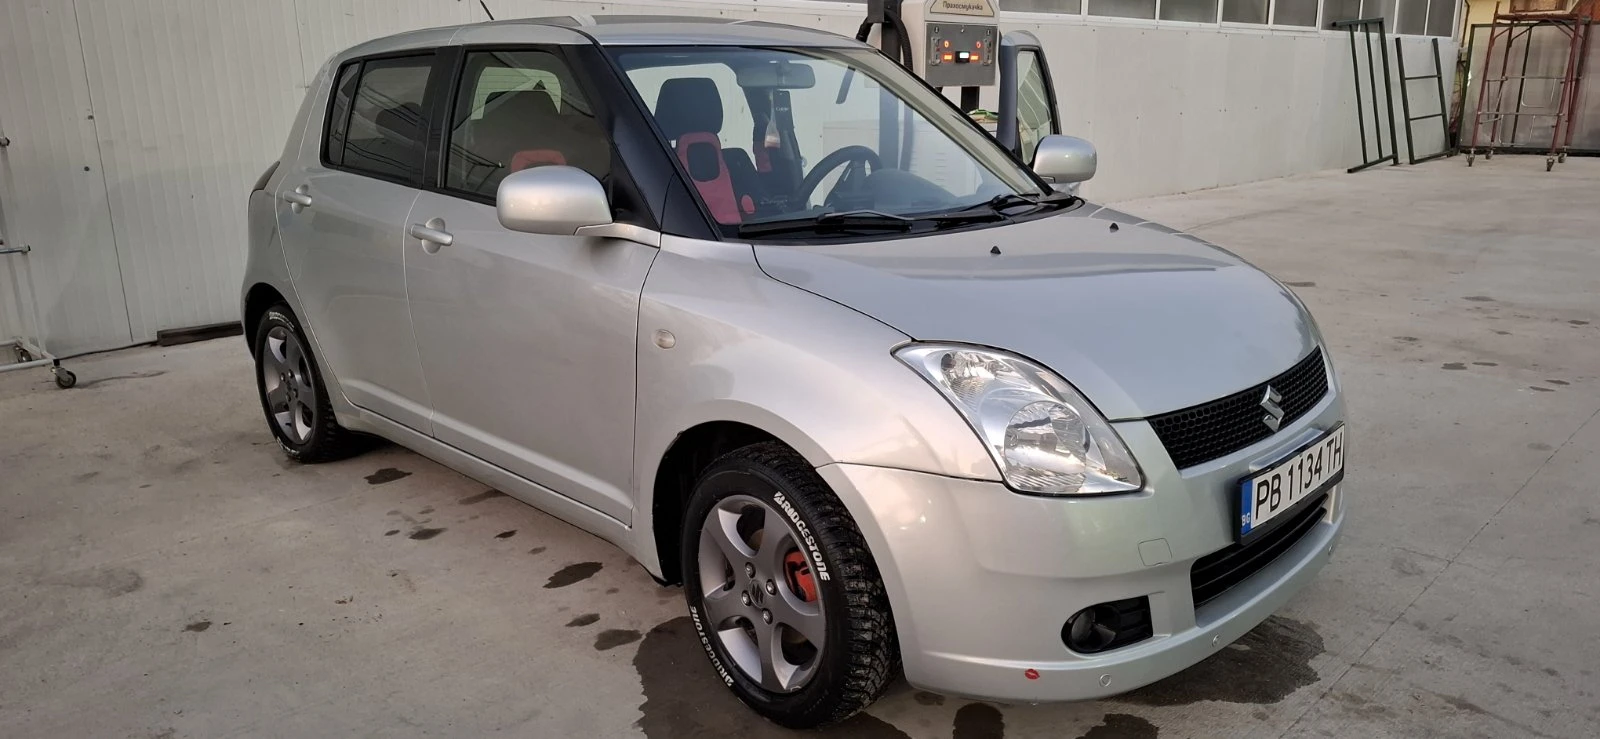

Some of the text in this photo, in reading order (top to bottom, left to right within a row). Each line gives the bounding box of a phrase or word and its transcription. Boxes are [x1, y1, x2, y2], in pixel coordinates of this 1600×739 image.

[1241, 513, 1251, 526] BG
[1255, 432, 1343, 520] PB 1134 TH
[773, 491, 831, 582] BRIDGESTONE
